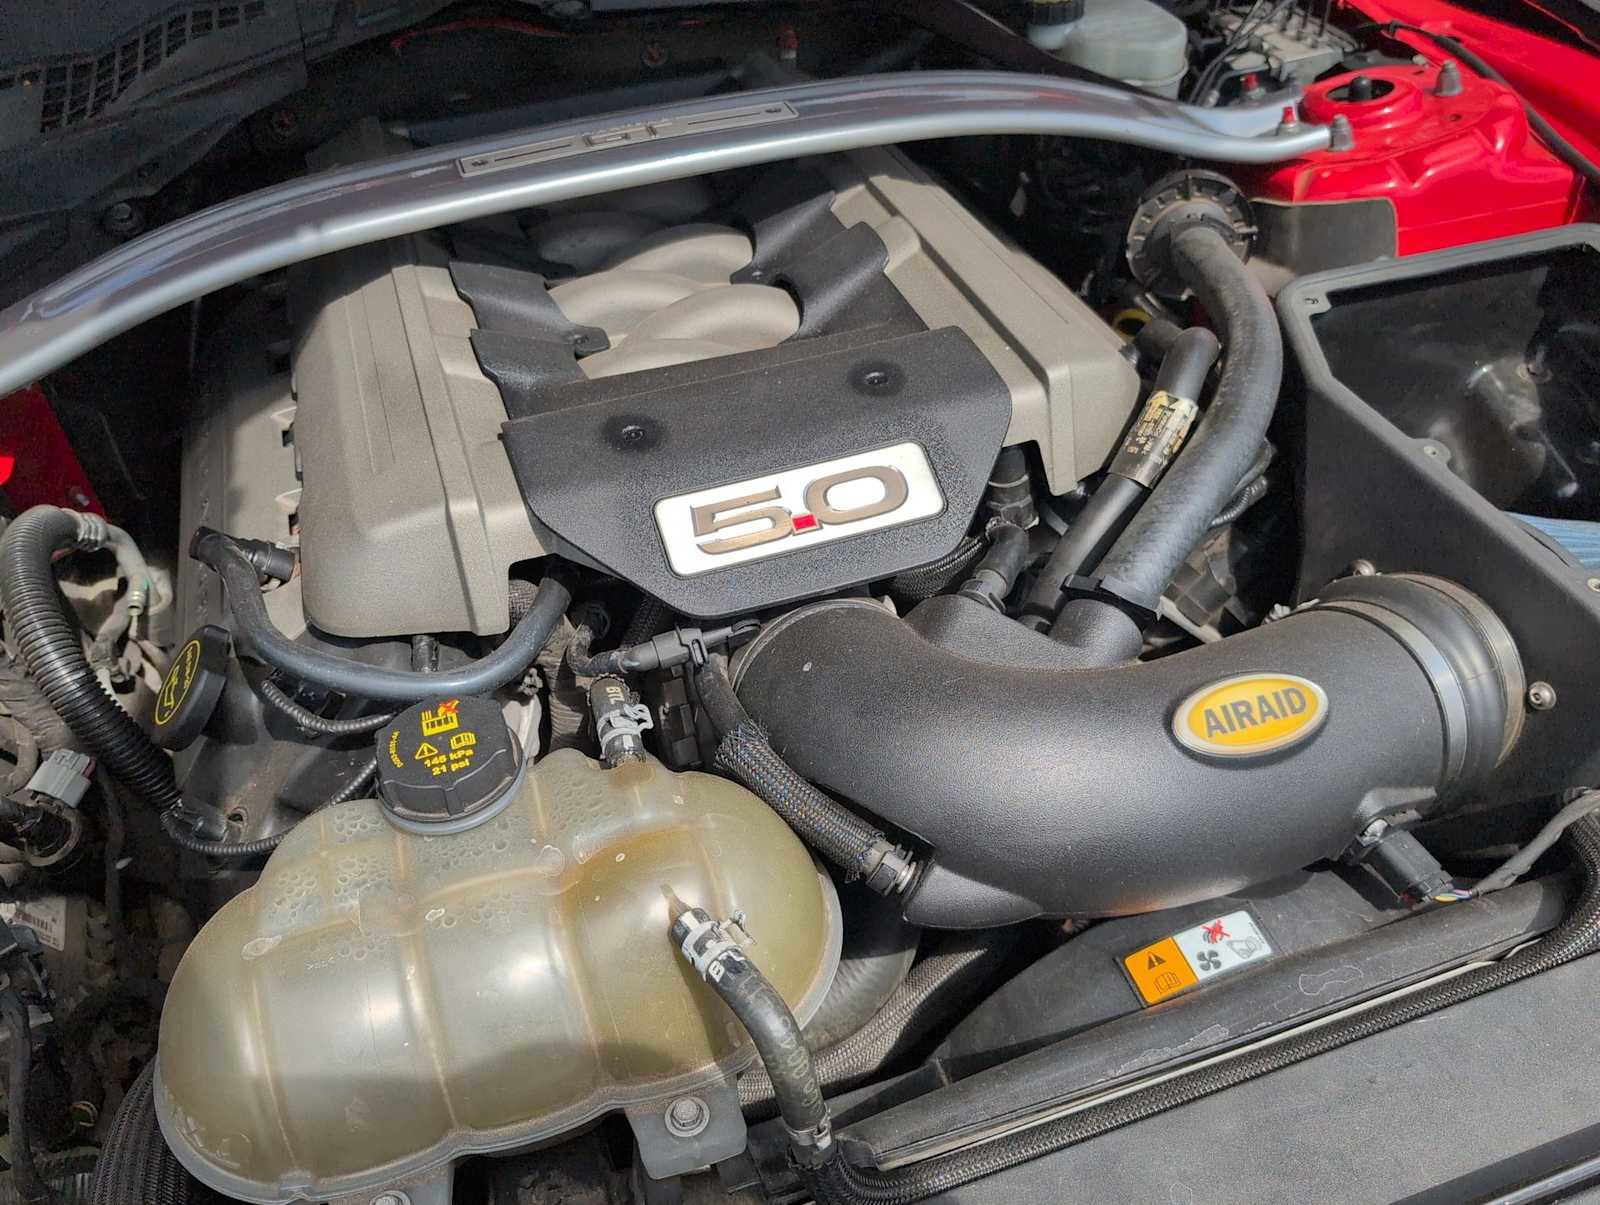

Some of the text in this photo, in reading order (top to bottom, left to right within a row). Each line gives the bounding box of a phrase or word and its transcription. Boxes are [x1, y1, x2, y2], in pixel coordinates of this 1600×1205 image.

[690, 464, 909, 555] 5.0
[1203, 687, 1307, 738] AIRAID
[424, 749, 474, 767] 145 kPa
[431, 758, 470, 776] 21 psi
